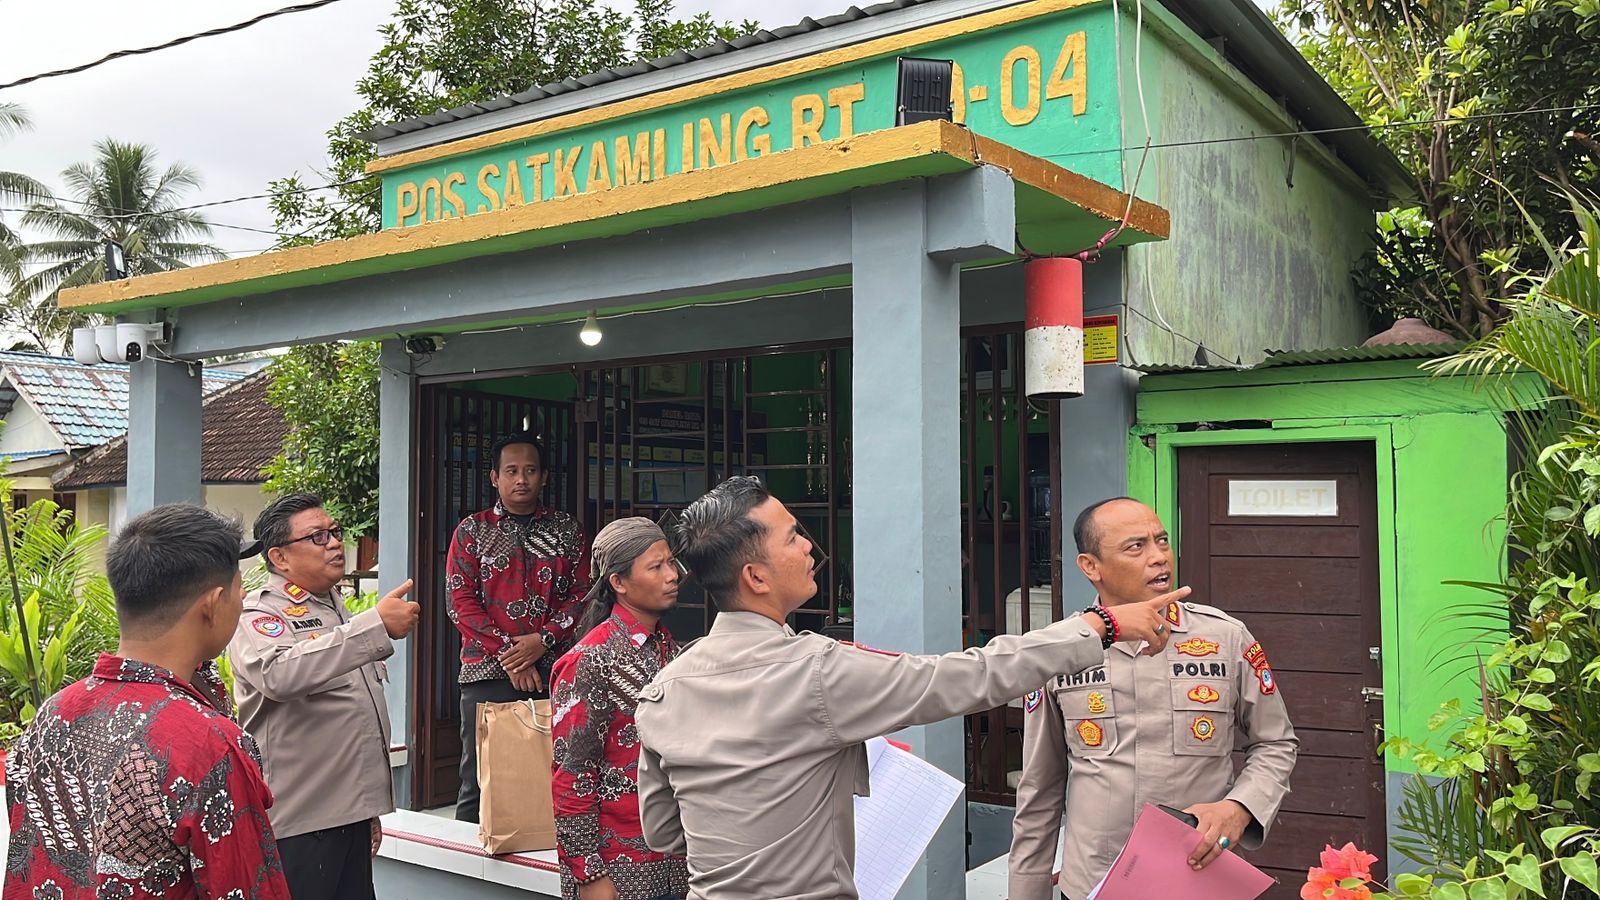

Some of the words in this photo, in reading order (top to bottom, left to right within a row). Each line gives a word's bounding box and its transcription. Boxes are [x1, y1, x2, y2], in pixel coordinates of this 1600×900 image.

[396, 172, 466, 227] POS
[791, 83, 865, 150] RT
[1239, 487, 1328, 508] TOILET
[1173, 663, 1227, 677] POLRI
